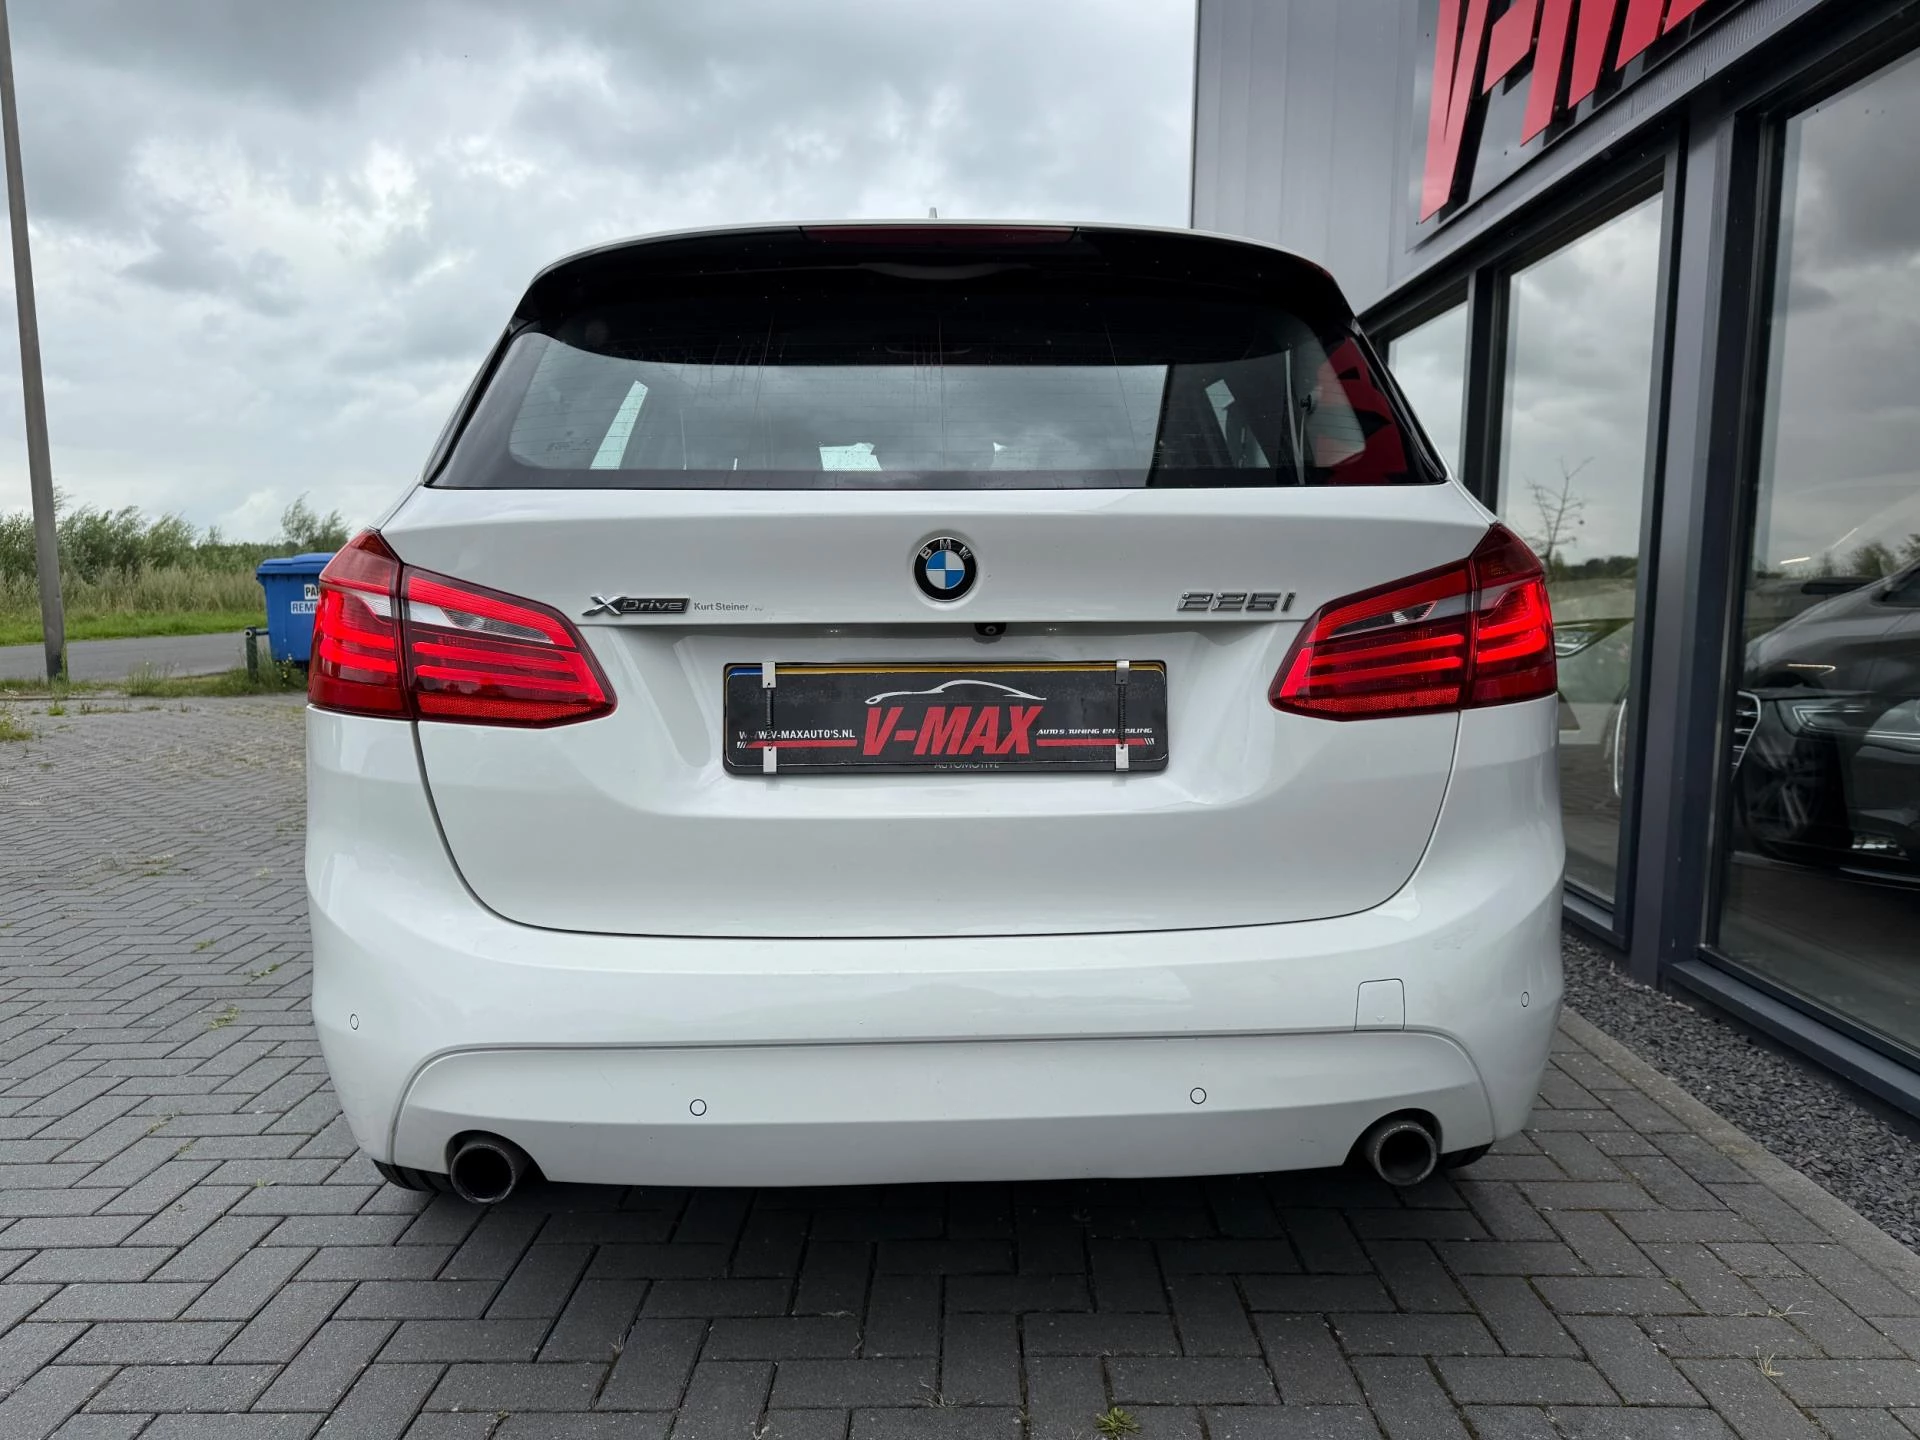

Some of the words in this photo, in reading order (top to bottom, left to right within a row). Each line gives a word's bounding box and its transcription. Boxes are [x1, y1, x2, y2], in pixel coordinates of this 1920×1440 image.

[920, 539, 972, 560] BMW
[694, 602, 714, 611] Kurt
[715, 602, 750, 611] Steiner
[1177, 592, 1296, 612] 225i
[739, 729, 856, 740] WW.V-MAXAUTO'S.NL
[863, 706, 1044, 756] V-MAX
